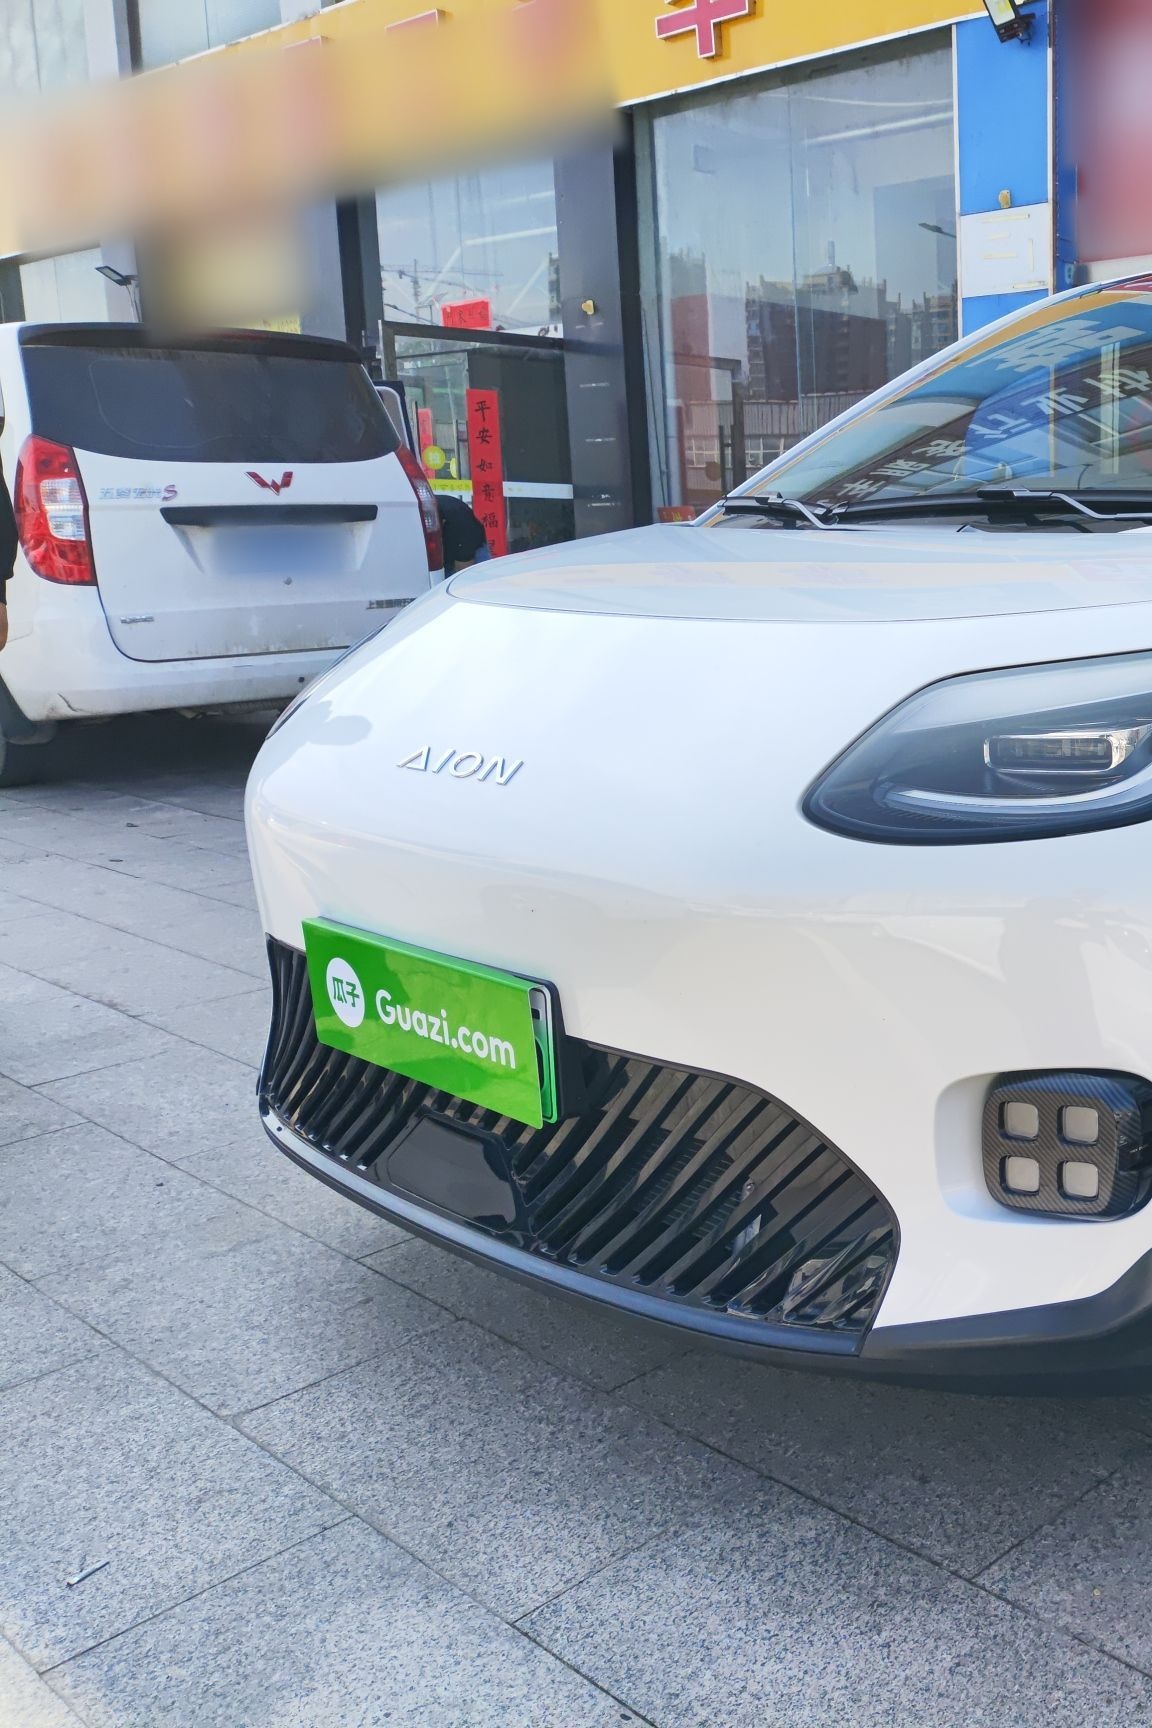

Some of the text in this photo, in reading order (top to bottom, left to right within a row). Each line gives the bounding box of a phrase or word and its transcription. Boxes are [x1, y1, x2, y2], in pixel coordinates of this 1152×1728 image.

[396, 744, 524, 786] AION
[332, 976, 360, 1008] 瓜子
[375, 989, 516, 1069] Guazi.com
